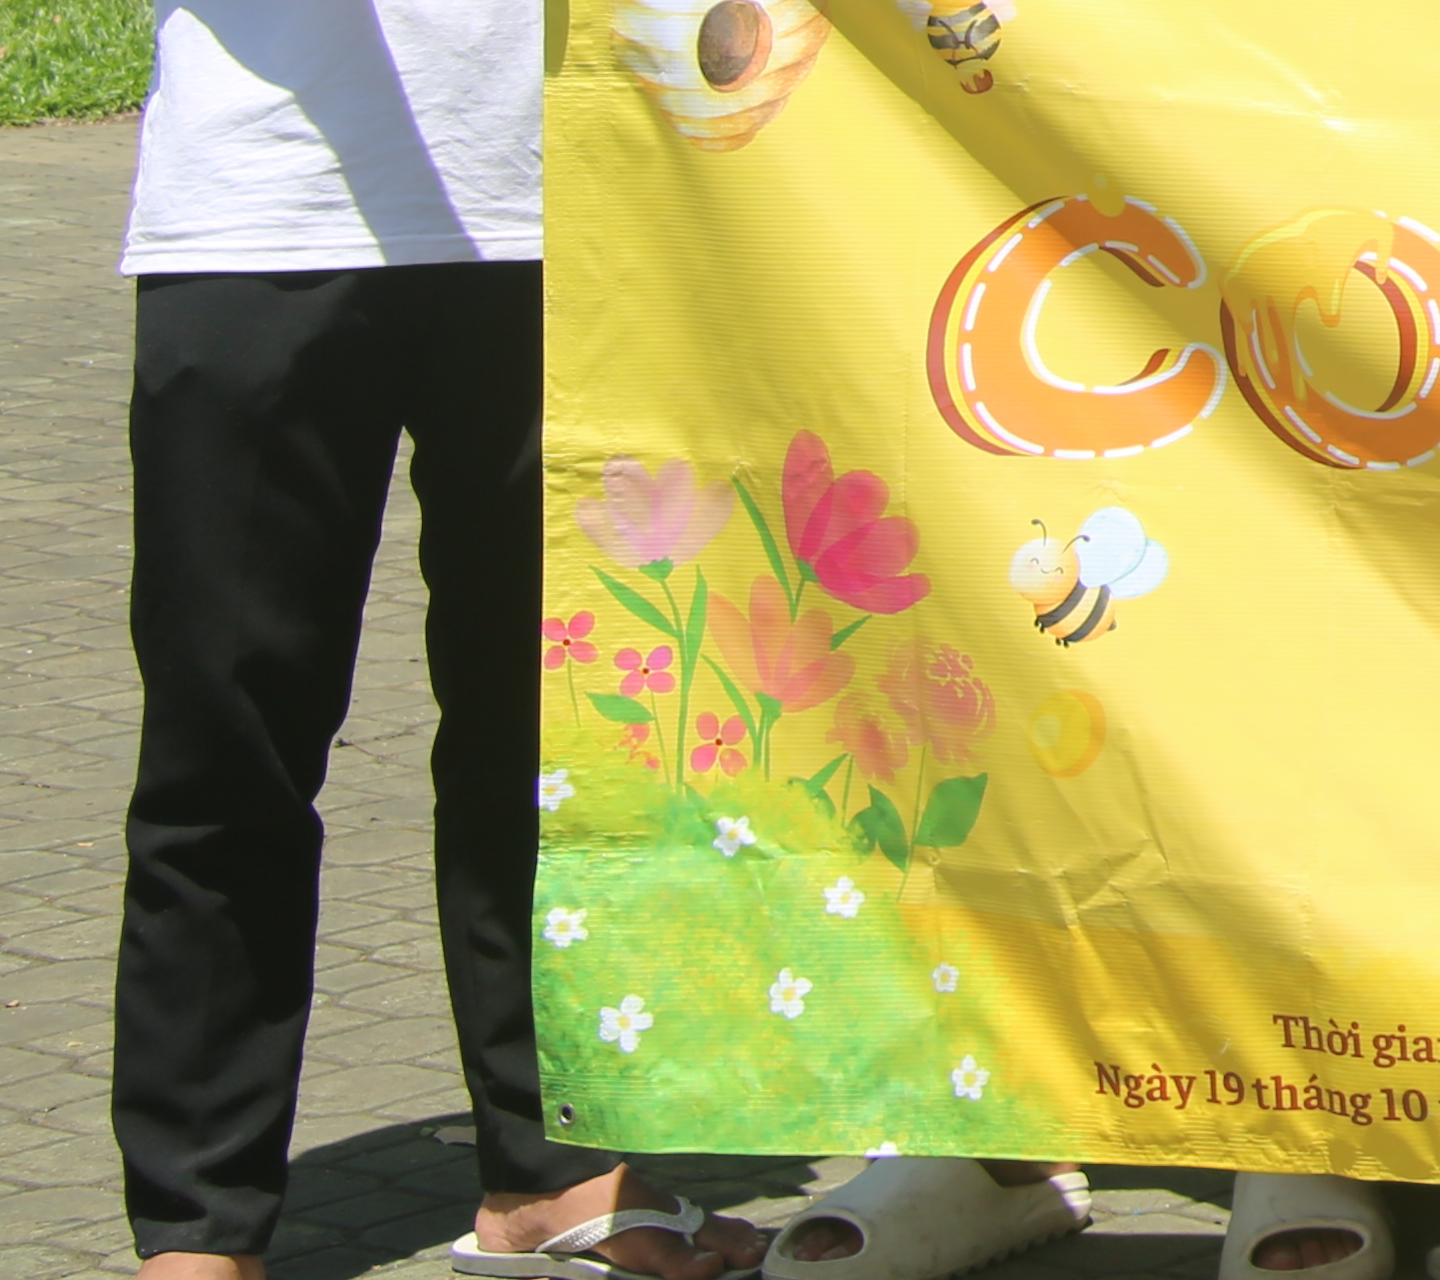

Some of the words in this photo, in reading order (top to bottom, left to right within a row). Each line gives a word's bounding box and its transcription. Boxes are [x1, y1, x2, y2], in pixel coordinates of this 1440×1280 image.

[1272, 1013, 1365, 1058] Thời
[1093, 1061, 1196, 1112] Ngày
[1203, 1067, 1246, 1107] 19
[1252, 1072, 1373, 1126] tháng
[1380, 1088, 1429, 1123] 10
